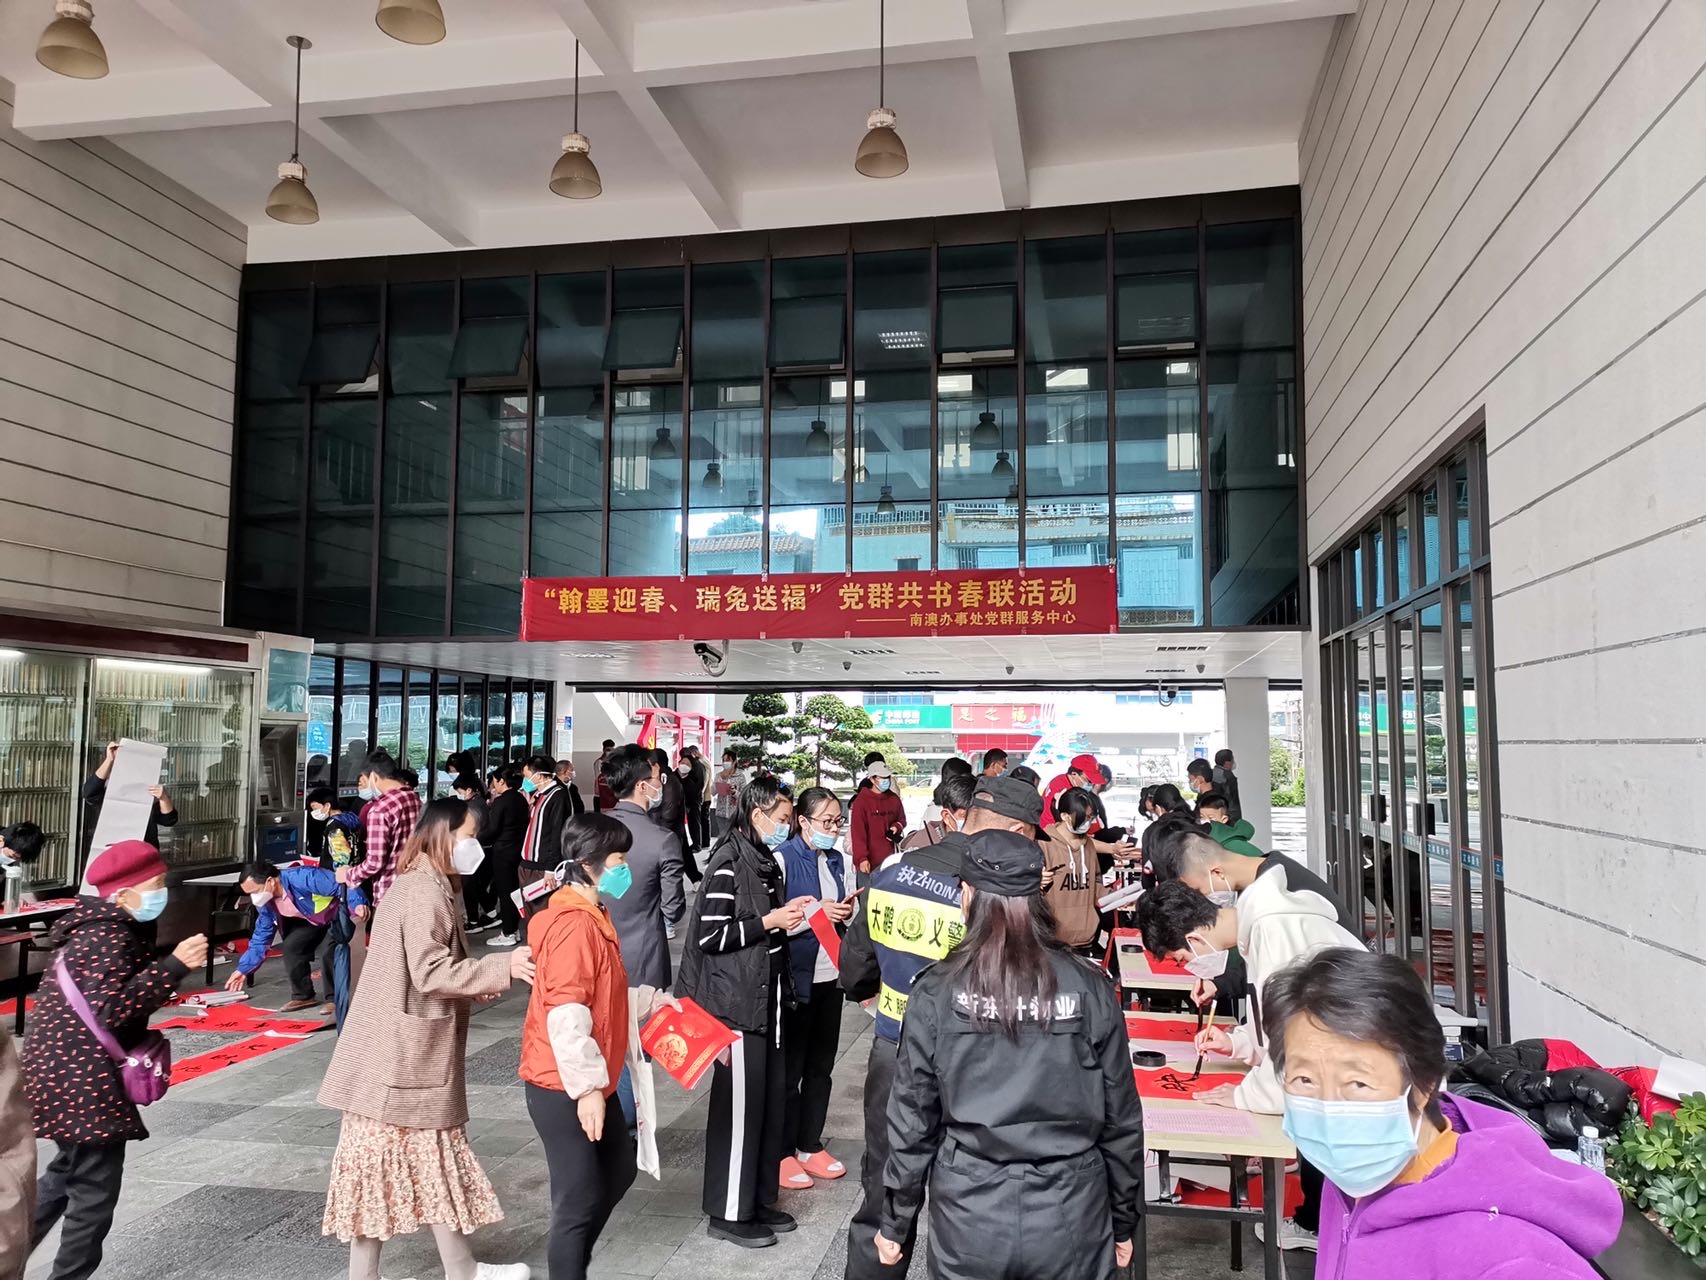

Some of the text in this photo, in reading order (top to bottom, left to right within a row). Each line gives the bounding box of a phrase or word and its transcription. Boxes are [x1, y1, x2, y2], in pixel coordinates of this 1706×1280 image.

[544, 577, 1077, 614] “翰墨迎春、瑞兔送福” 党群共书春联活动
